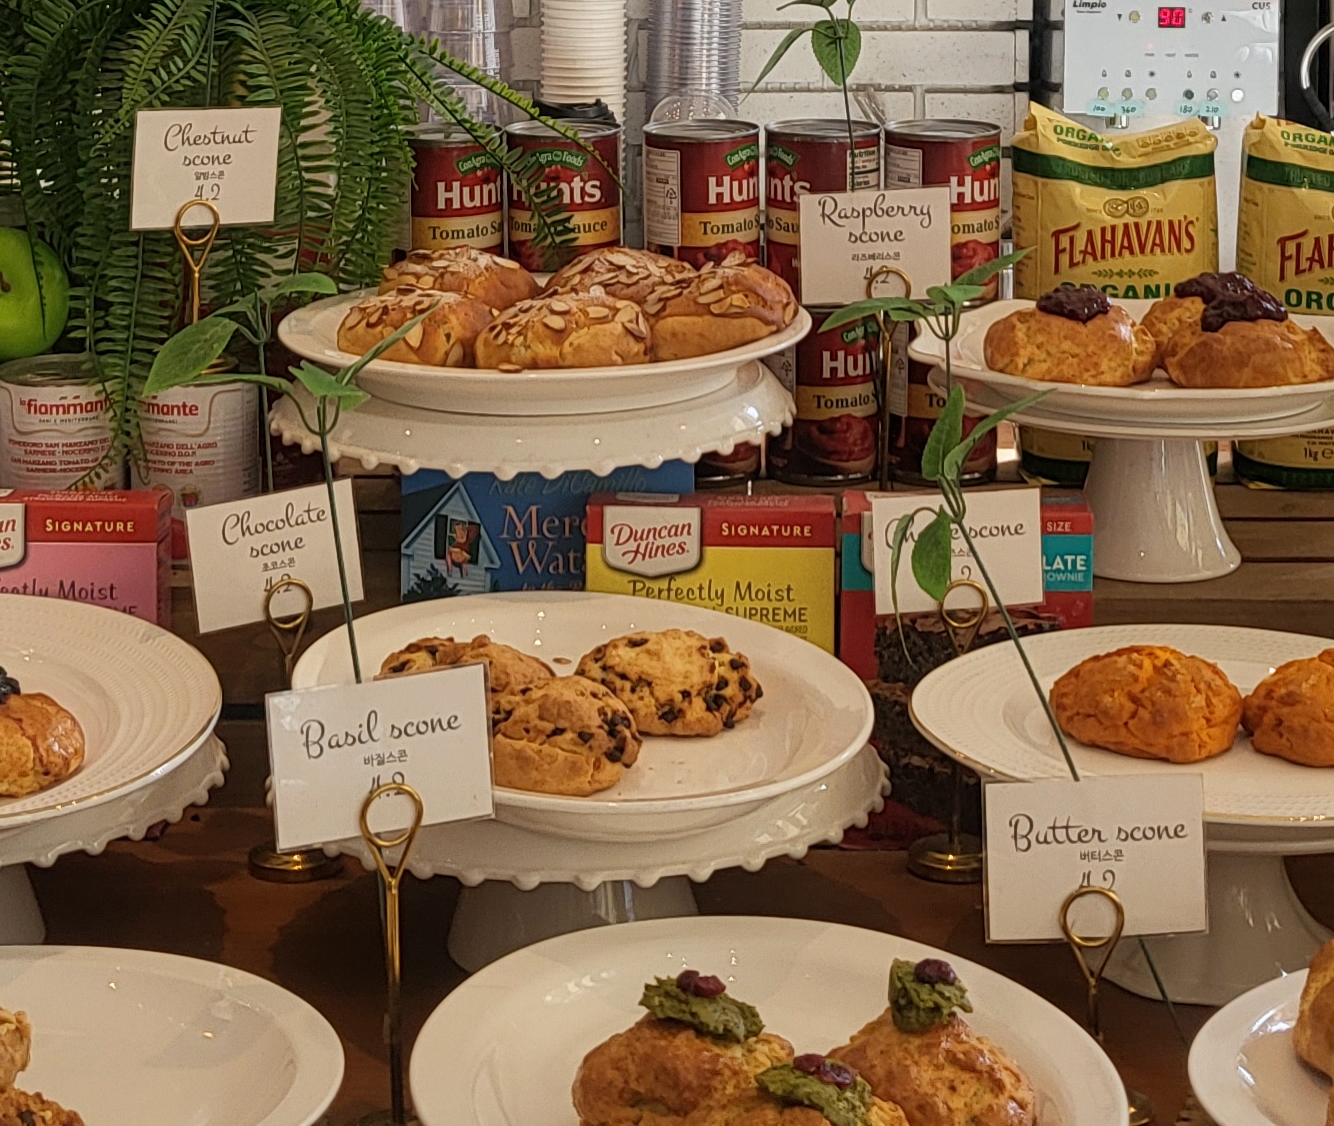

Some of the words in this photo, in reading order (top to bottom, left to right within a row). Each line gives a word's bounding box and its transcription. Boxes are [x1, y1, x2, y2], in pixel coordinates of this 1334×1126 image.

[1072, 0, 1107, 10] Limpio
[1121, 105, 1137, 114] 360
[1205, 105, 1220, 113] 210
[163, 123, 258, 152] Chestnut
[182, 153, 233, 167] scone
[194, 182, 221, 202] 4.2
[818, 193, 932, 231] Raspberry
[429, 224, 489, 241] Tomato
[699, 219, 755, 236] Tomato
[847, 229, 906, 244] scone
[1051, 214, 1195, 277] FLAHAVAN'S
[814, 393, 871, 410] Tomato
[45, 519, 135, 533] SIGNATURE
[221, 501, 328, 545] Chocolate
[721, 522, 812, 537] SIGNATURE
[967, 522, 1026, 538] scone
[1046, 521, 1072, 532] SIZE
[610, 521, 692, 546] Duncan
[249, 535, 306, 558] scone
[621, 541, 686, 565] Hines
[58, 579, 119, 601] Moist
[263, 573, 293, 595] 4.2
[627, 575, 725, 607] Perfectly
[733, 580, 796, 603] Moist
[300, 710, 381, 760] Basil
[389, 713, 462, 740] scone
[363, 749, 409, 767] 바질스콘
[1008, 813, 1108, 853] Butter
[1115, 823, 1189, 842] scone
[1079, 849, 1125, 863] 버터스콘
